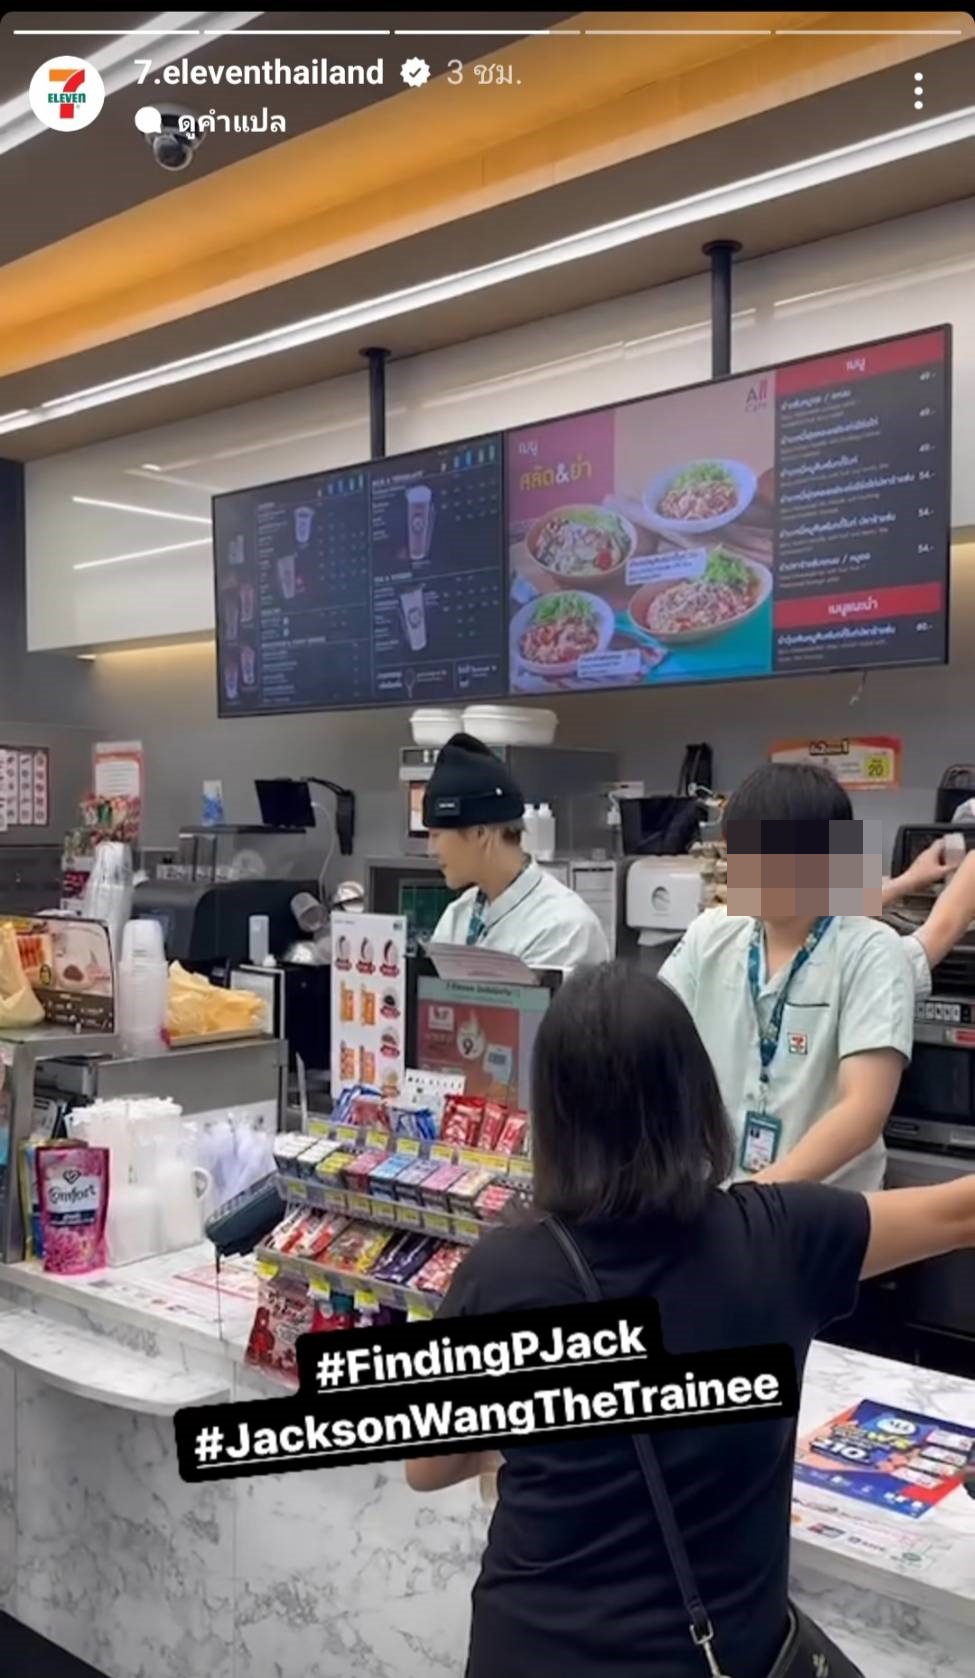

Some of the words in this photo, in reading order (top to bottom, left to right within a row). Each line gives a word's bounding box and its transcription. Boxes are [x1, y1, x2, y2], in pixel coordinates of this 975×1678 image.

[868, 763, 884, 777] 20
[463, 1038, 474, 1055] 9
[48, 1185, 96, 1204] Comfort
